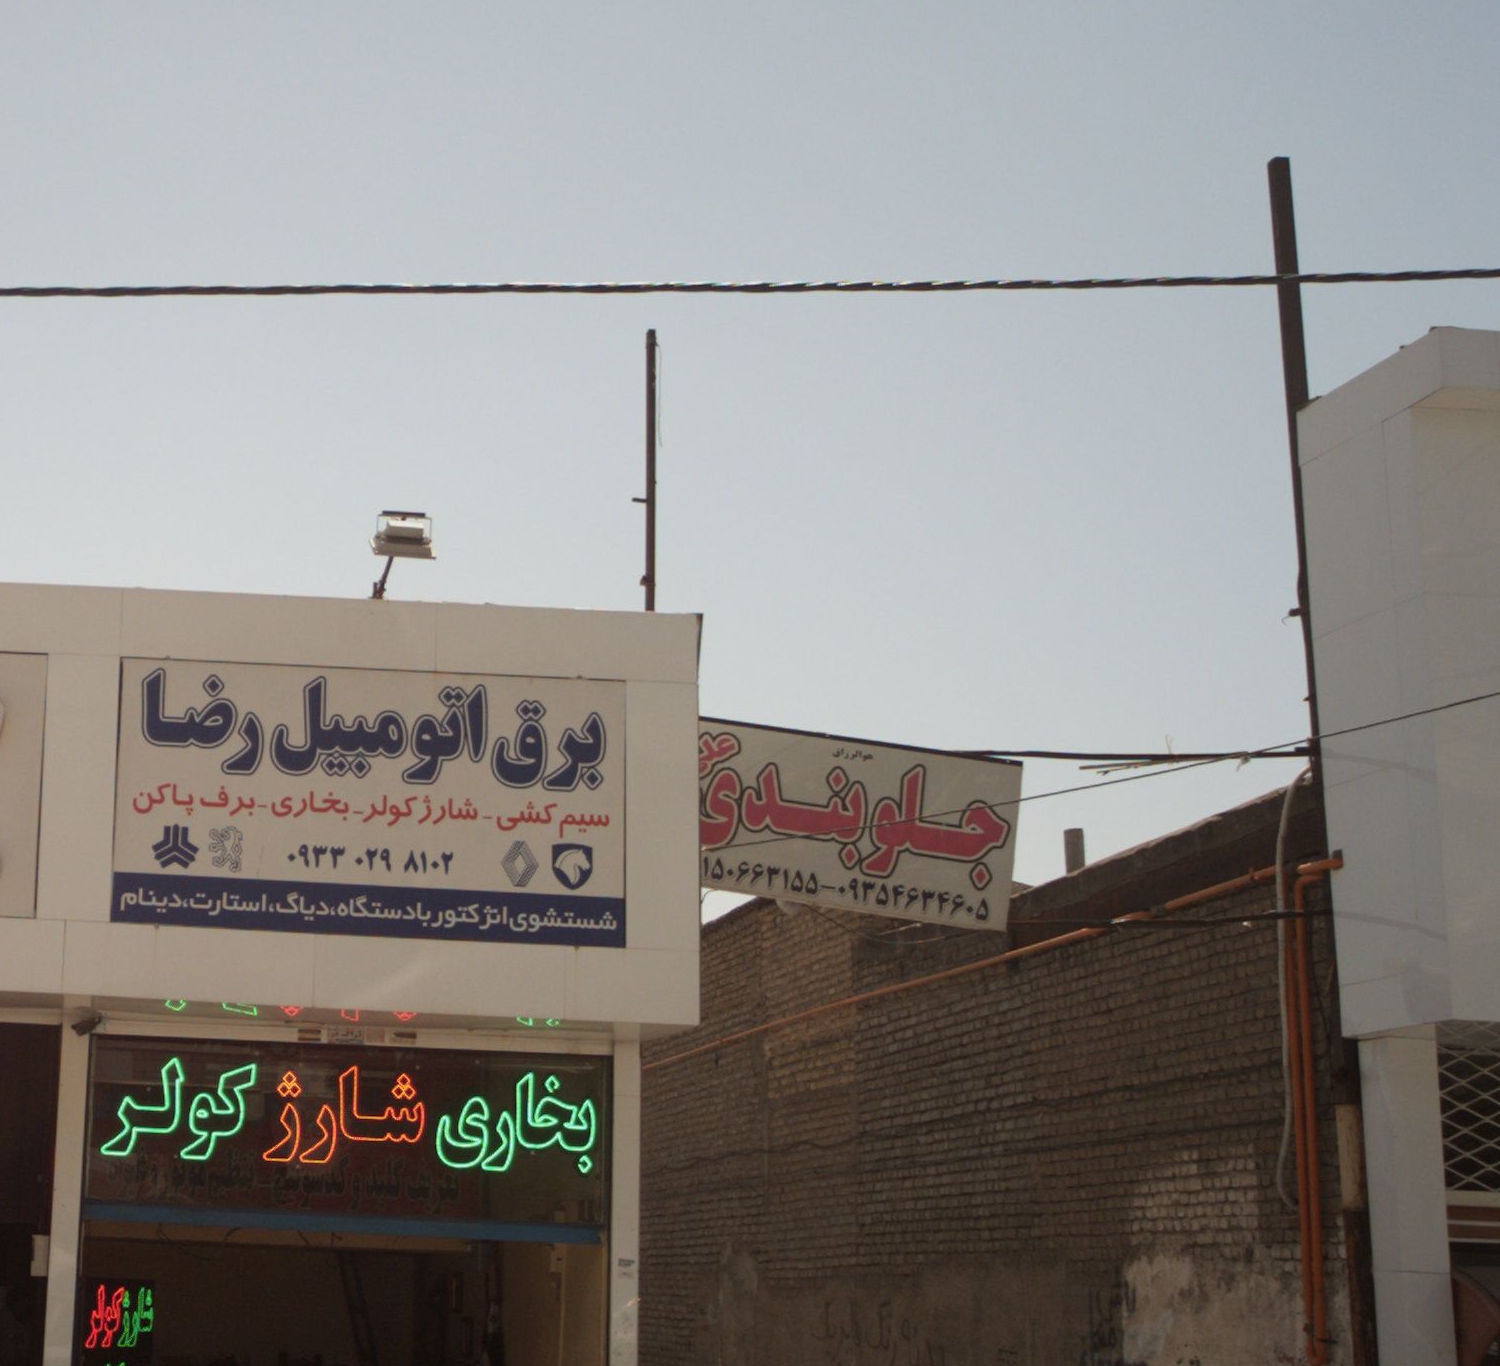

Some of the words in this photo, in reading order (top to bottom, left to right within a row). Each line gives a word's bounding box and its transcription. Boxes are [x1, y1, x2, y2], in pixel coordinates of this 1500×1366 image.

[141, 668, 264, 776] رضا
[269, 675, 488, 786] اتومبیل
[491, 699, 608, 792] برق
[132, 782, 195, 816] پاکن
[199, 785, 257, 817] برف
[270, 790, 351, 821] بخاری
[362, 795, 419, 827] کولر
[418, 794, 479, 825] شارژ
[496, 800, 559, 831] کشی
[559, 810, 611, 838] سیم
[286, 843, 346, 870] ۰۹۳۳
[354, 847, 392, 873] ۰۲۹
[403, 849, 454, 876] ۸۱۰۲
[119, 887, 182, 914] دینام
[431, 902, 508, 929] انژکتور
[507, 907, 618, 932] شستشوی
[100, 1056, 259, 1161] کولر
[262, 1065, 427, 1165] شارژ
[434, 1070, 599, 1176] بخاری
